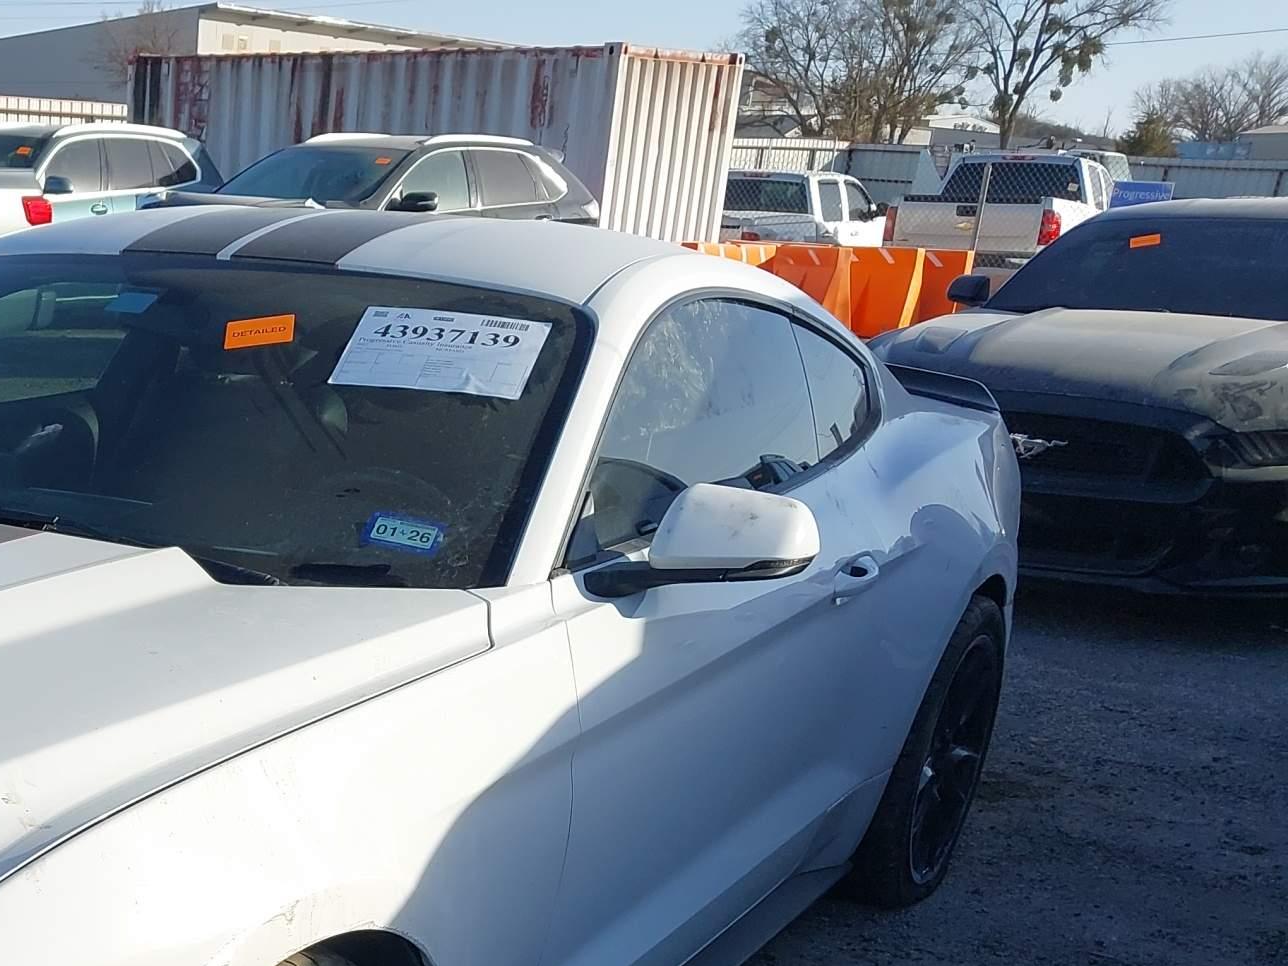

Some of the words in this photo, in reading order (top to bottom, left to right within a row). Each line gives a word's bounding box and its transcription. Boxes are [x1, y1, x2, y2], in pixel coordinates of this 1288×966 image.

[1113, 187, 1171, 201] Progressive
[232, 326, 287, 337] DETAILED
[373, 323, 520, 348] 43937139
